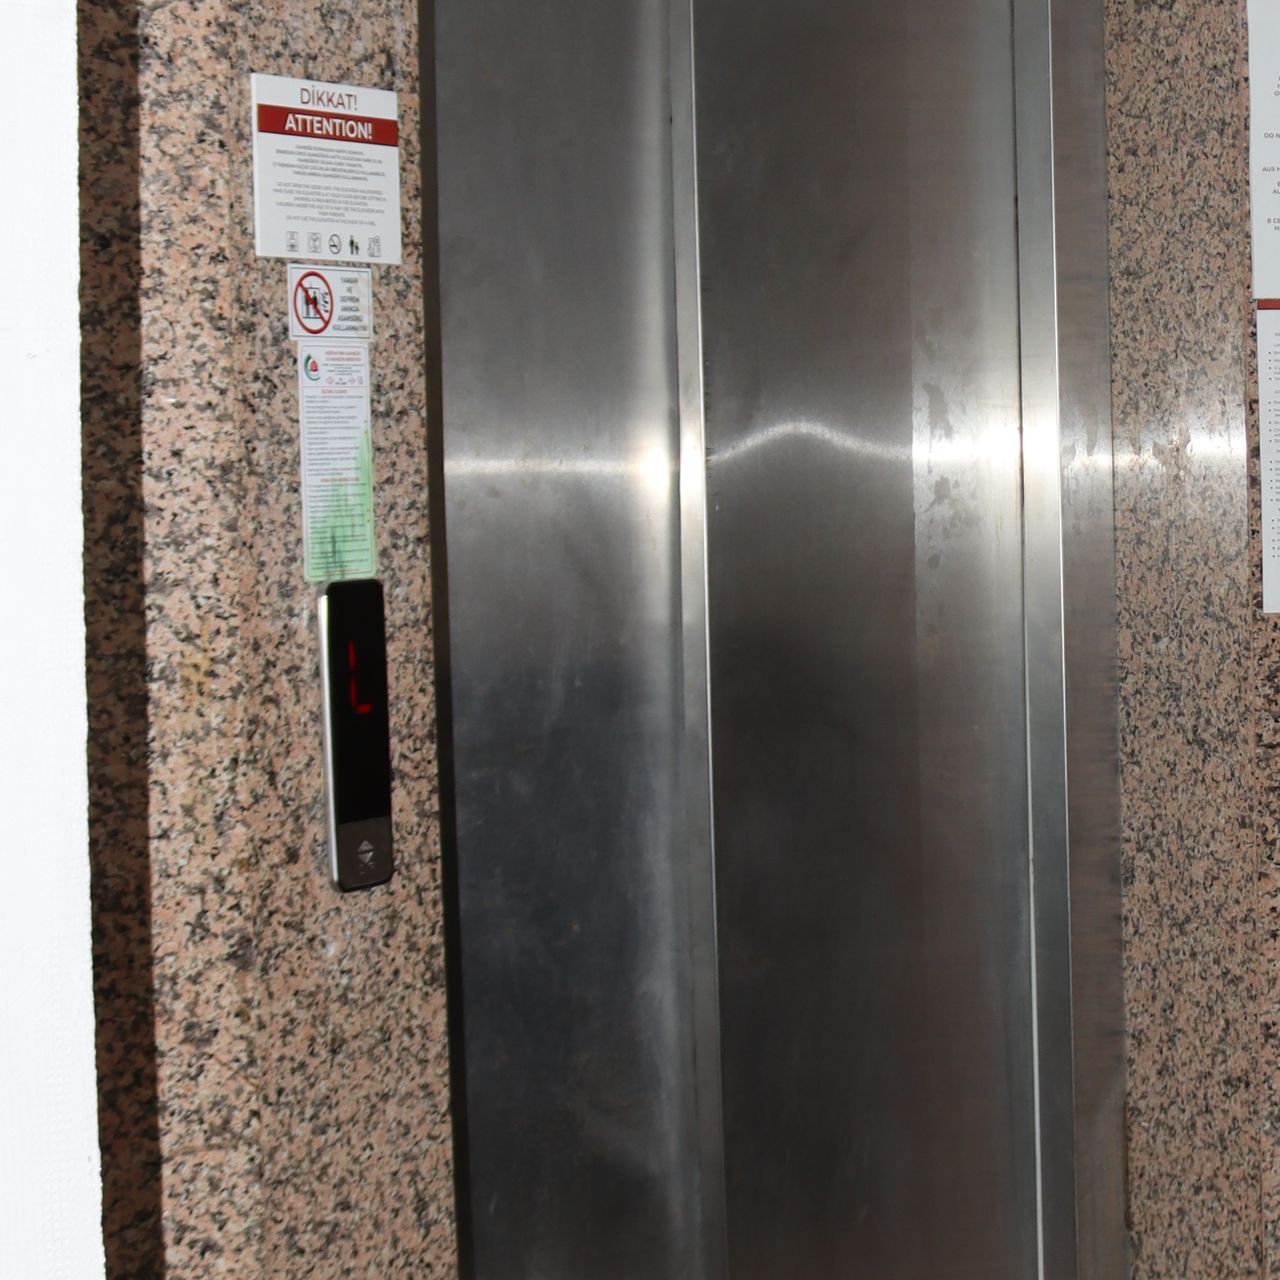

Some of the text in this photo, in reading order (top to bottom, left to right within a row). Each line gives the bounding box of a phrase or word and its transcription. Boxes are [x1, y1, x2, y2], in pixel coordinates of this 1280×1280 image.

[300, 85, 358, 111] DİKKAT!
[284, 113, 373, 140] ATTENTION!
[347, 639, 372, 714] L
